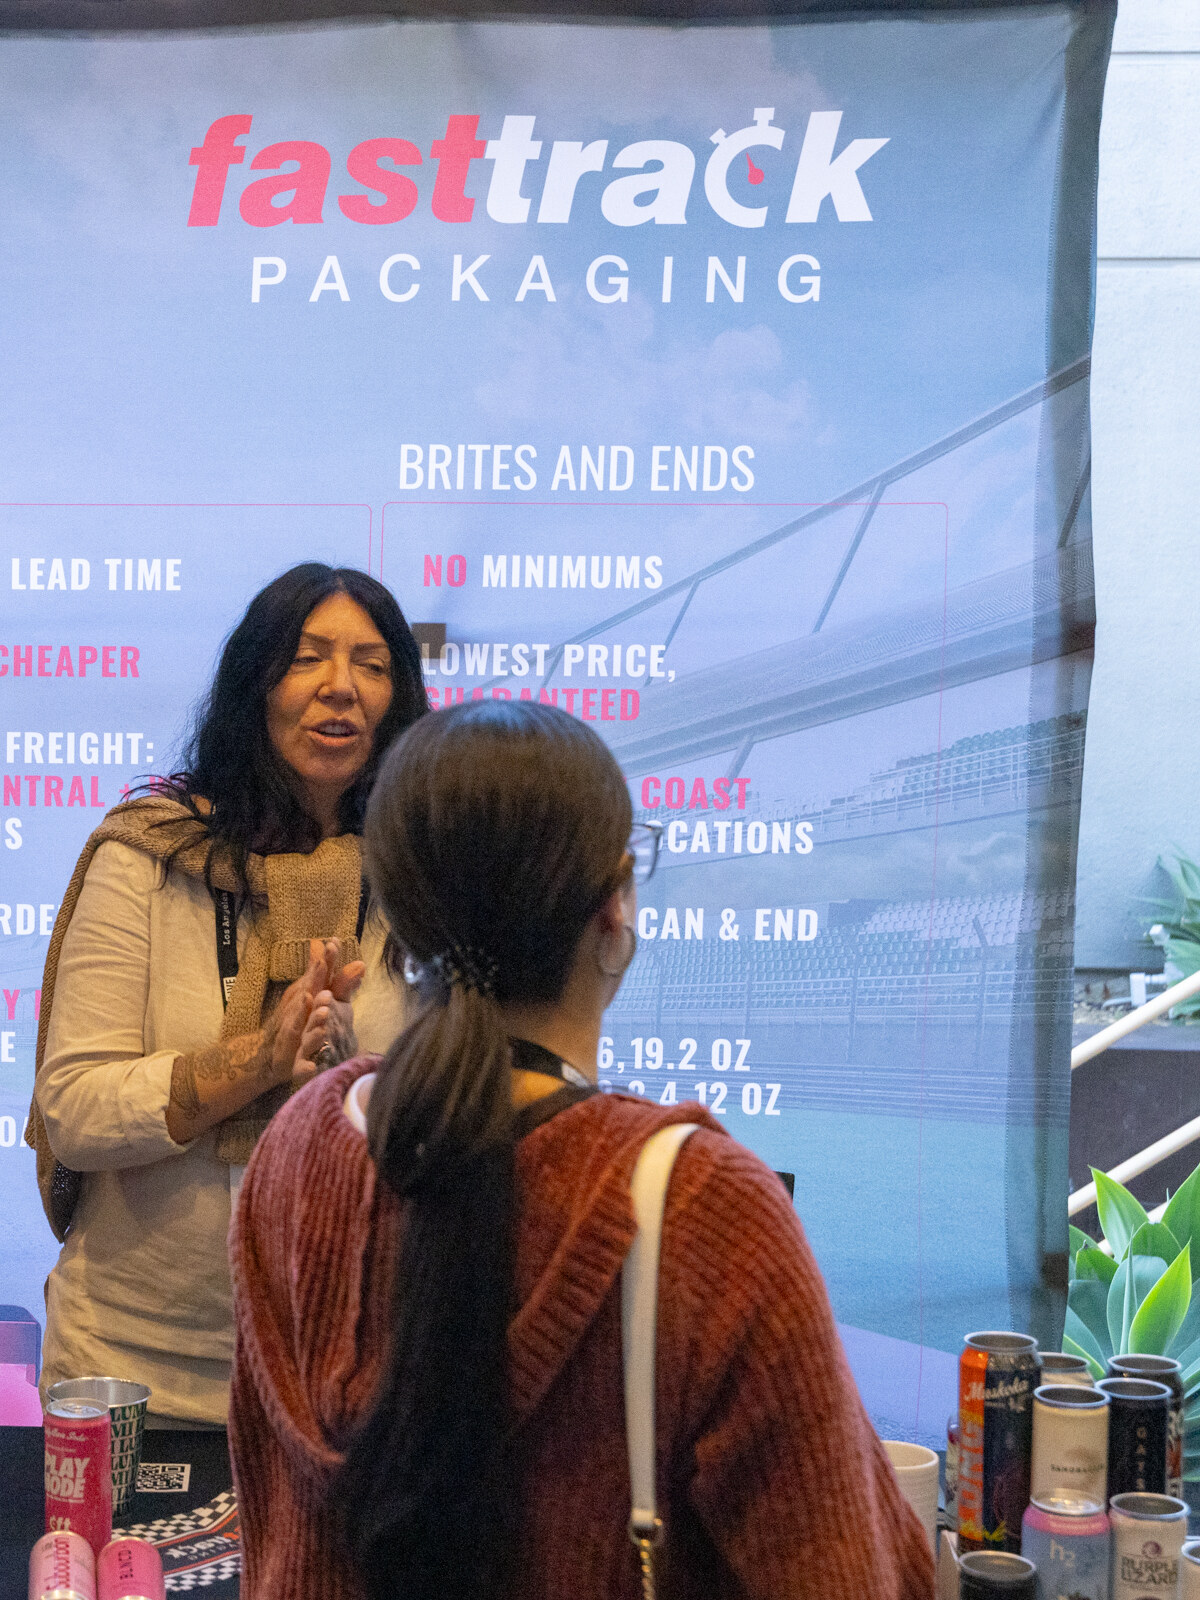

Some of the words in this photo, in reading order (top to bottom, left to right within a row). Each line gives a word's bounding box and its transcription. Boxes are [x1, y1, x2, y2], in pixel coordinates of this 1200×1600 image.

[186, 107, 892, 228] fasttrack
[250, 253, 823, 304] PACKAGING
[399, 443, 538, 491] BRITES
[551, 444, 635, 492] AND
[650, 444, 756, 493] ENDS
[10, 558, 91, 591] LEAD
[104, 558, 182, 592] TIME
[422, 554, 468, 588] NO
[482, 554, 664, 589] MINIMUMS
[421, 642, 550, 676] LOWEST
[563, 644, 676, 683] PRICE,
[5, 731, 154, 765] FREIGHT:
[641, 776, 752, 810] COAST
[222, 929, 231, 946] Los
[637, 906, 705, 940] CAN
[719, 907, 740, 941] &
[754, 908, 819, 942] END
[711, 1038, 752, 1072] OZ
[741, 1082, 782, 1116] OZ
